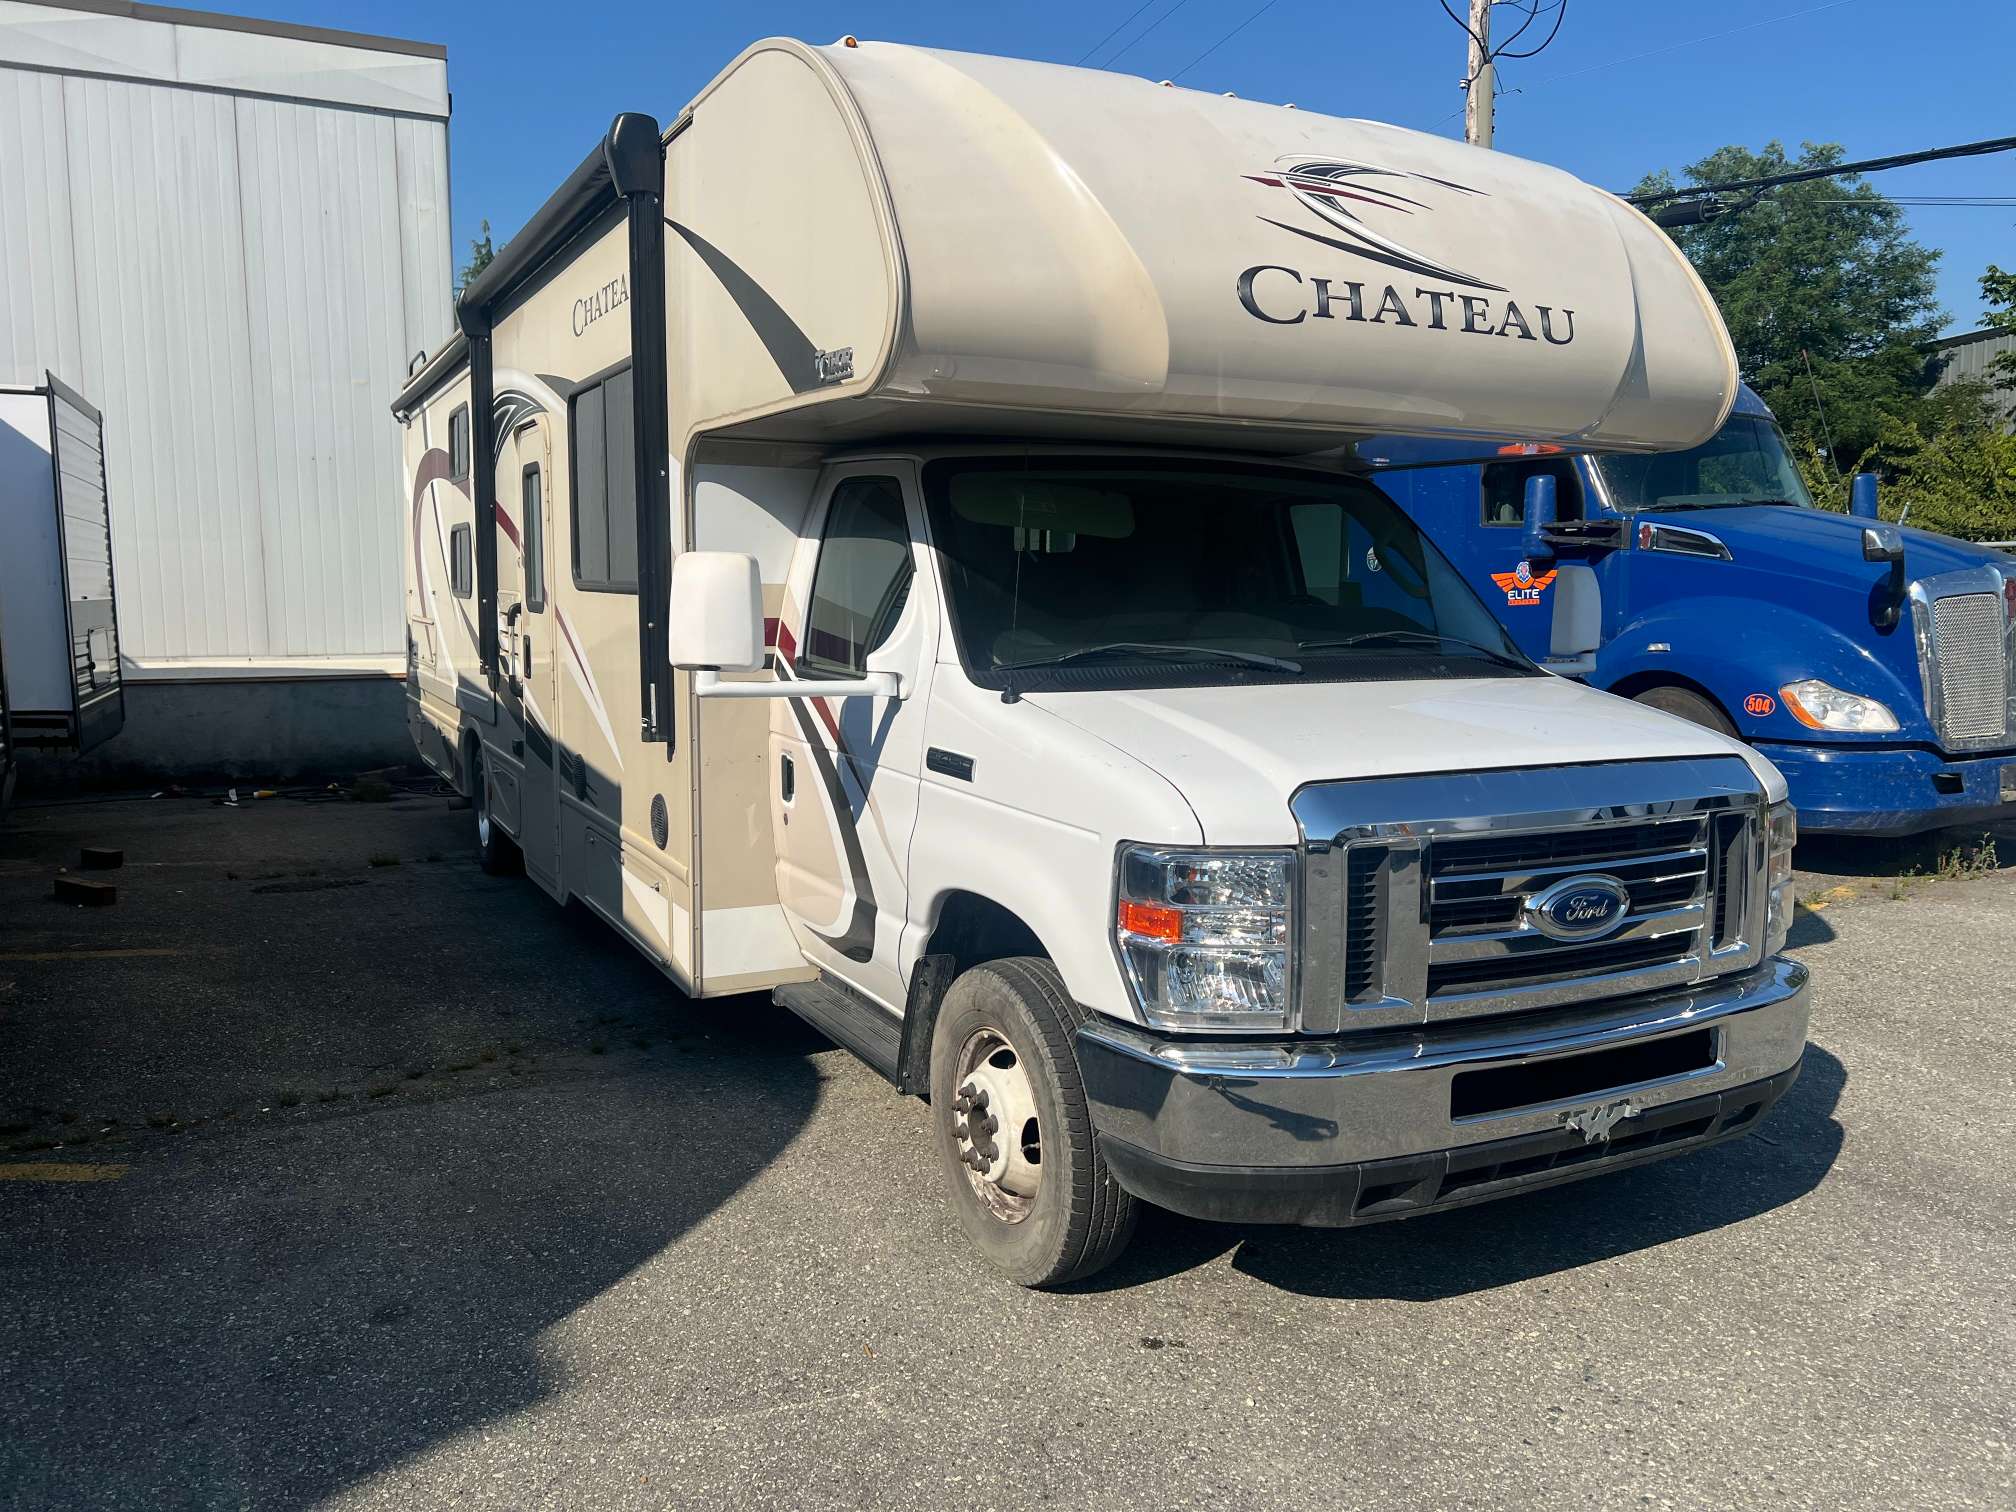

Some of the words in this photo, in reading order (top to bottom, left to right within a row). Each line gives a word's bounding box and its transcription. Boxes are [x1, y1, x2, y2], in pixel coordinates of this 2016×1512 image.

[1236, 264, 1575, 346] CHATEAU
[1507, 589, 1540, 600] ELITE
[1747, 697, 1770, 713] 504
[1566, 895, 1608, 921] Ford
